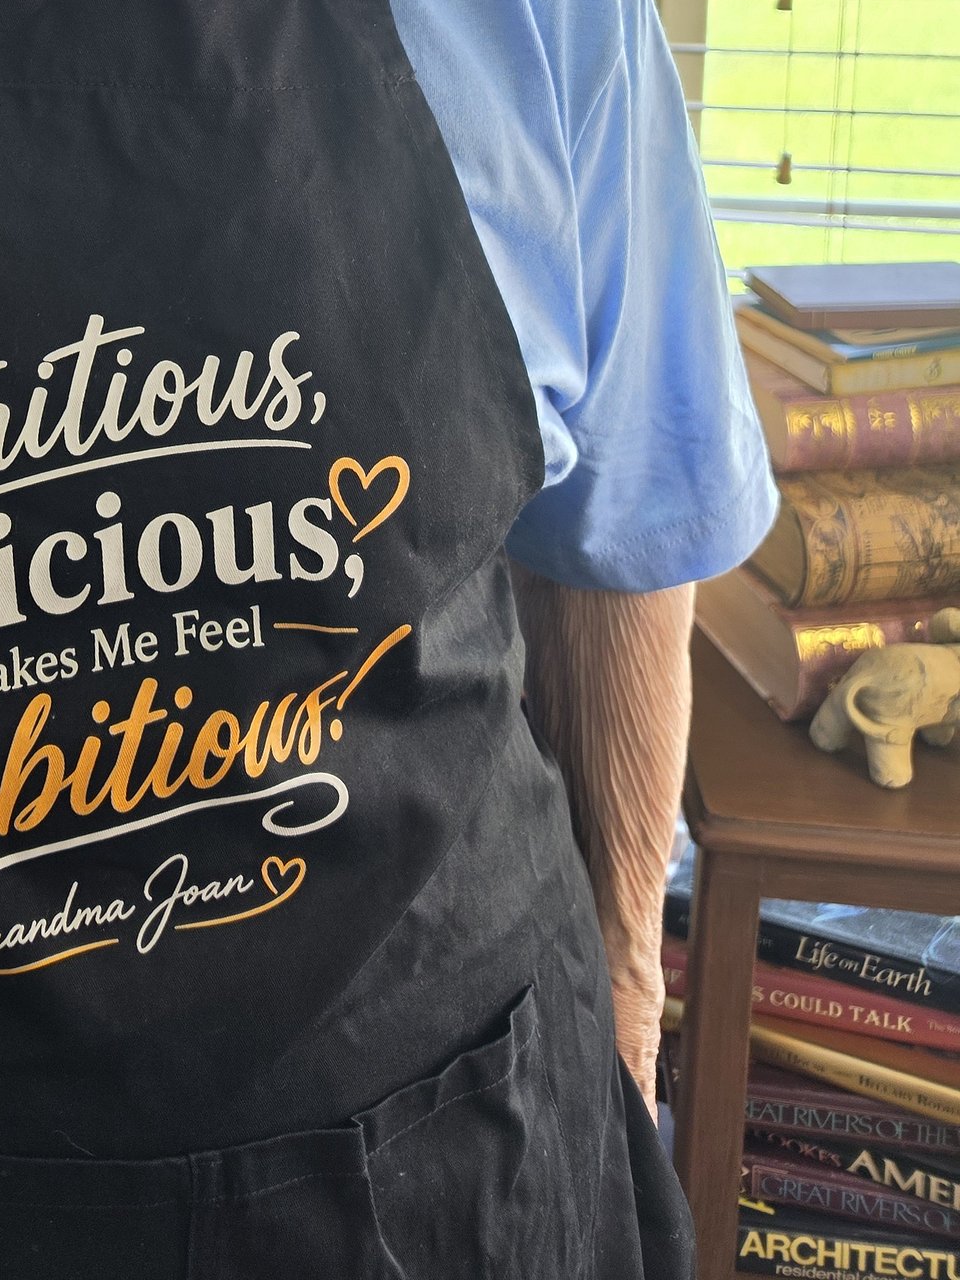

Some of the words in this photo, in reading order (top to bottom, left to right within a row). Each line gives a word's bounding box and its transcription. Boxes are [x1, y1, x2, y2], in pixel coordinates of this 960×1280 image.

[91, 627, 160, 671] Me
[173, 605, 266, 657] Feel
[136, 853, 254, 956] Joan
[795, 935, 838, 970] Life
[839, 958, 860, 972] on
[859, 952, 932, 997] Earth
[769, 988, 843, 1018] COULD
[849, 1004, 913, 1034] TALK
[793, 1106, 874, 1136] RIVERS
[875, 1118, 905, 1141] OF
[912, 1122, 955, 1147] THE
[761, 1175, 838, 1208] GREAT
[841, 1190, 922, 1225] RIVERS
[923, 1208, 960, 1234] OF
